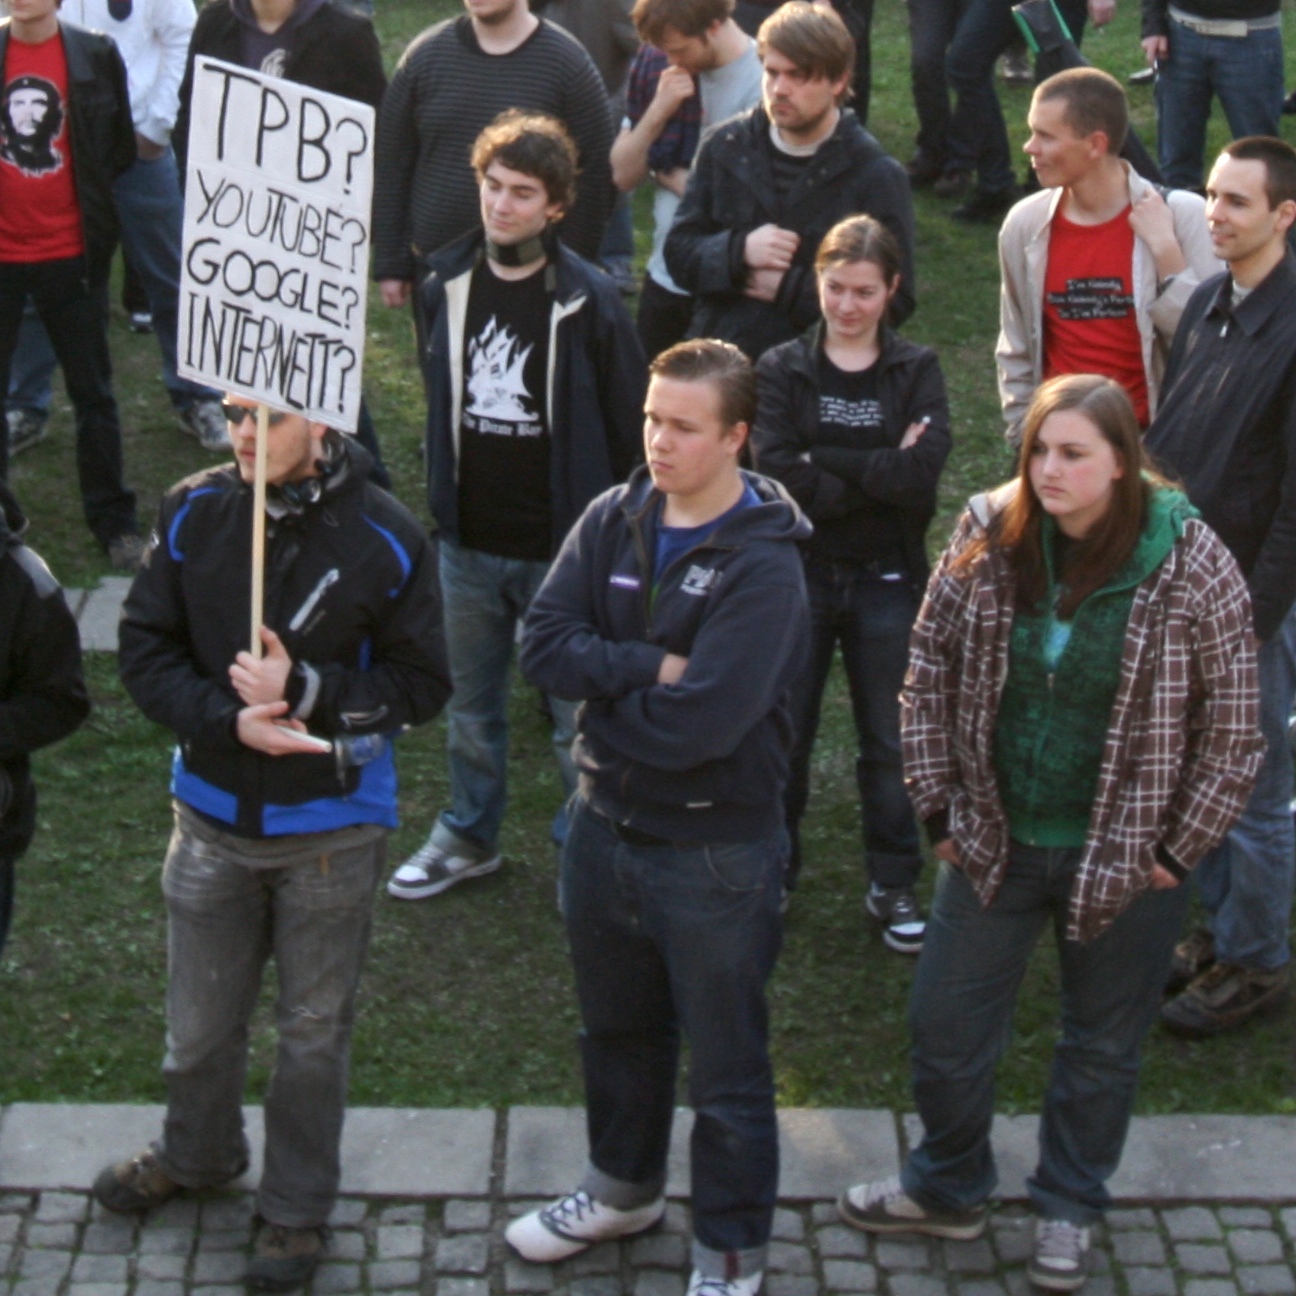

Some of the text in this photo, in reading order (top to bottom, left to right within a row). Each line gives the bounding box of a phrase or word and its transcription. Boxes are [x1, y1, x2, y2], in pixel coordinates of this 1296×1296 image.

[202, 63, 368, 195] TPB?
[195, 169, 366, 274] YOUTUBE?
[186, 237, 360, 330] GOOGLE?
